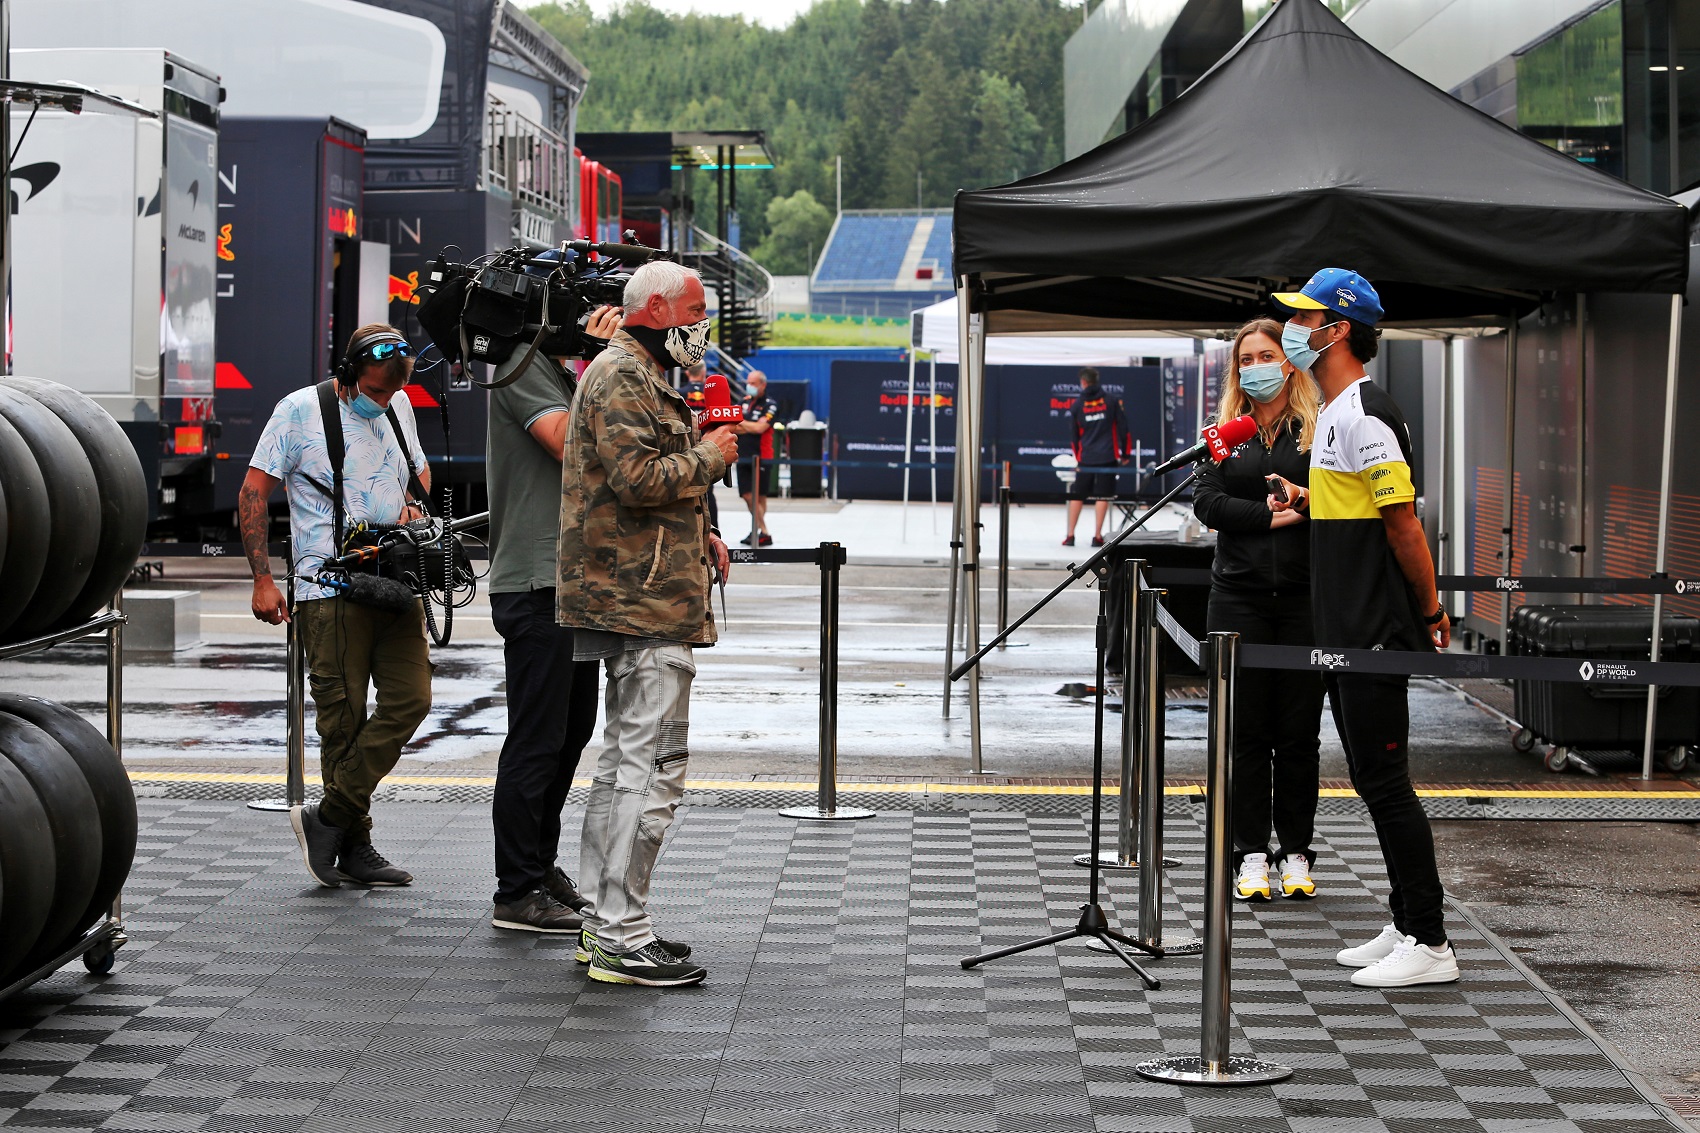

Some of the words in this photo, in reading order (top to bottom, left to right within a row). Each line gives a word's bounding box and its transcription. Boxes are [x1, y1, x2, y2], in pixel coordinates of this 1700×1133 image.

[178, 223, 206, 243] McLaren
[699, 409, 710, 425] ORF
[712, 407, 740, 418] ORF
[1208, 428, 1228, 456] ORF
[1364, 441, 1385, 451] WORLD
